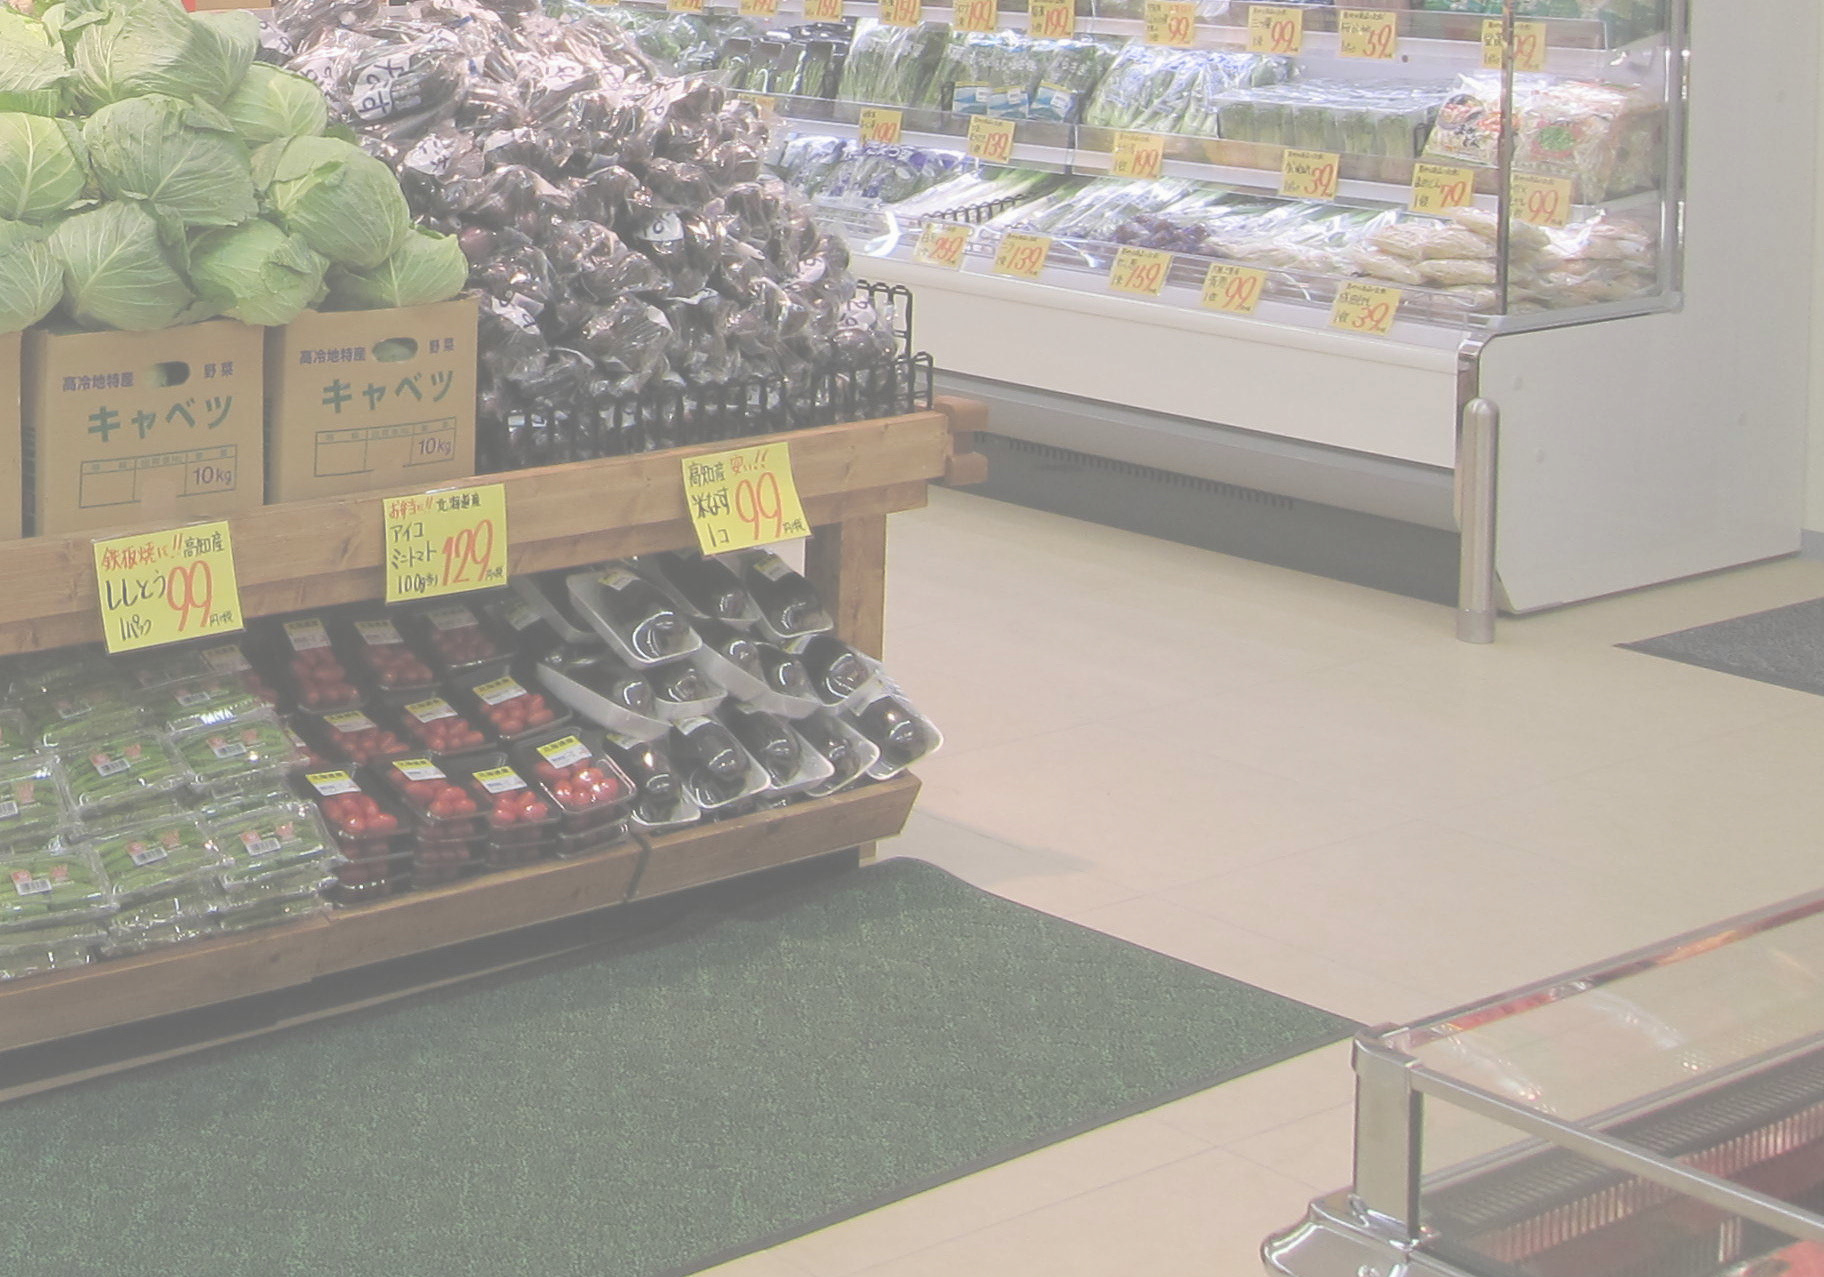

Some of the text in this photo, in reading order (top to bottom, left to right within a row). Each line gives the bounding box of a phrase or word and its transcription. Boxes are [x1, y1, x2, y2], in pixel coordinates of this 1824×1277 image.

[1168, 17, 1189, 44] 99
[1271, 20, 1295, 52] 99
[1363, 25, 1392, 59] 59
[1304, 164, 1334, 197] 39
[1528, 190, 1559, 222] 99
[1222, 276, 1257, 310] 99
[1352, 303, 1390, 335] 39
[299, 338, 455, 365] 高冷地特産 野菜
[62, 361, 234, 392] 高冷地特産 野菜
[322, 370, 454, 414] キャベツ
[87, 395, 233, 443] キャベツ
[418, 437, 452, 456] 10kg
[192, 466, 233, 485] 10kg
[735, 472, 782, 541] 99
[184, 530, 224, 558] 高知産
[390, 522, 425, 543] アイコ
[391, 519, 494, 586] ミニトマト 129
[105, 560, 213, 632] ししとう 99
